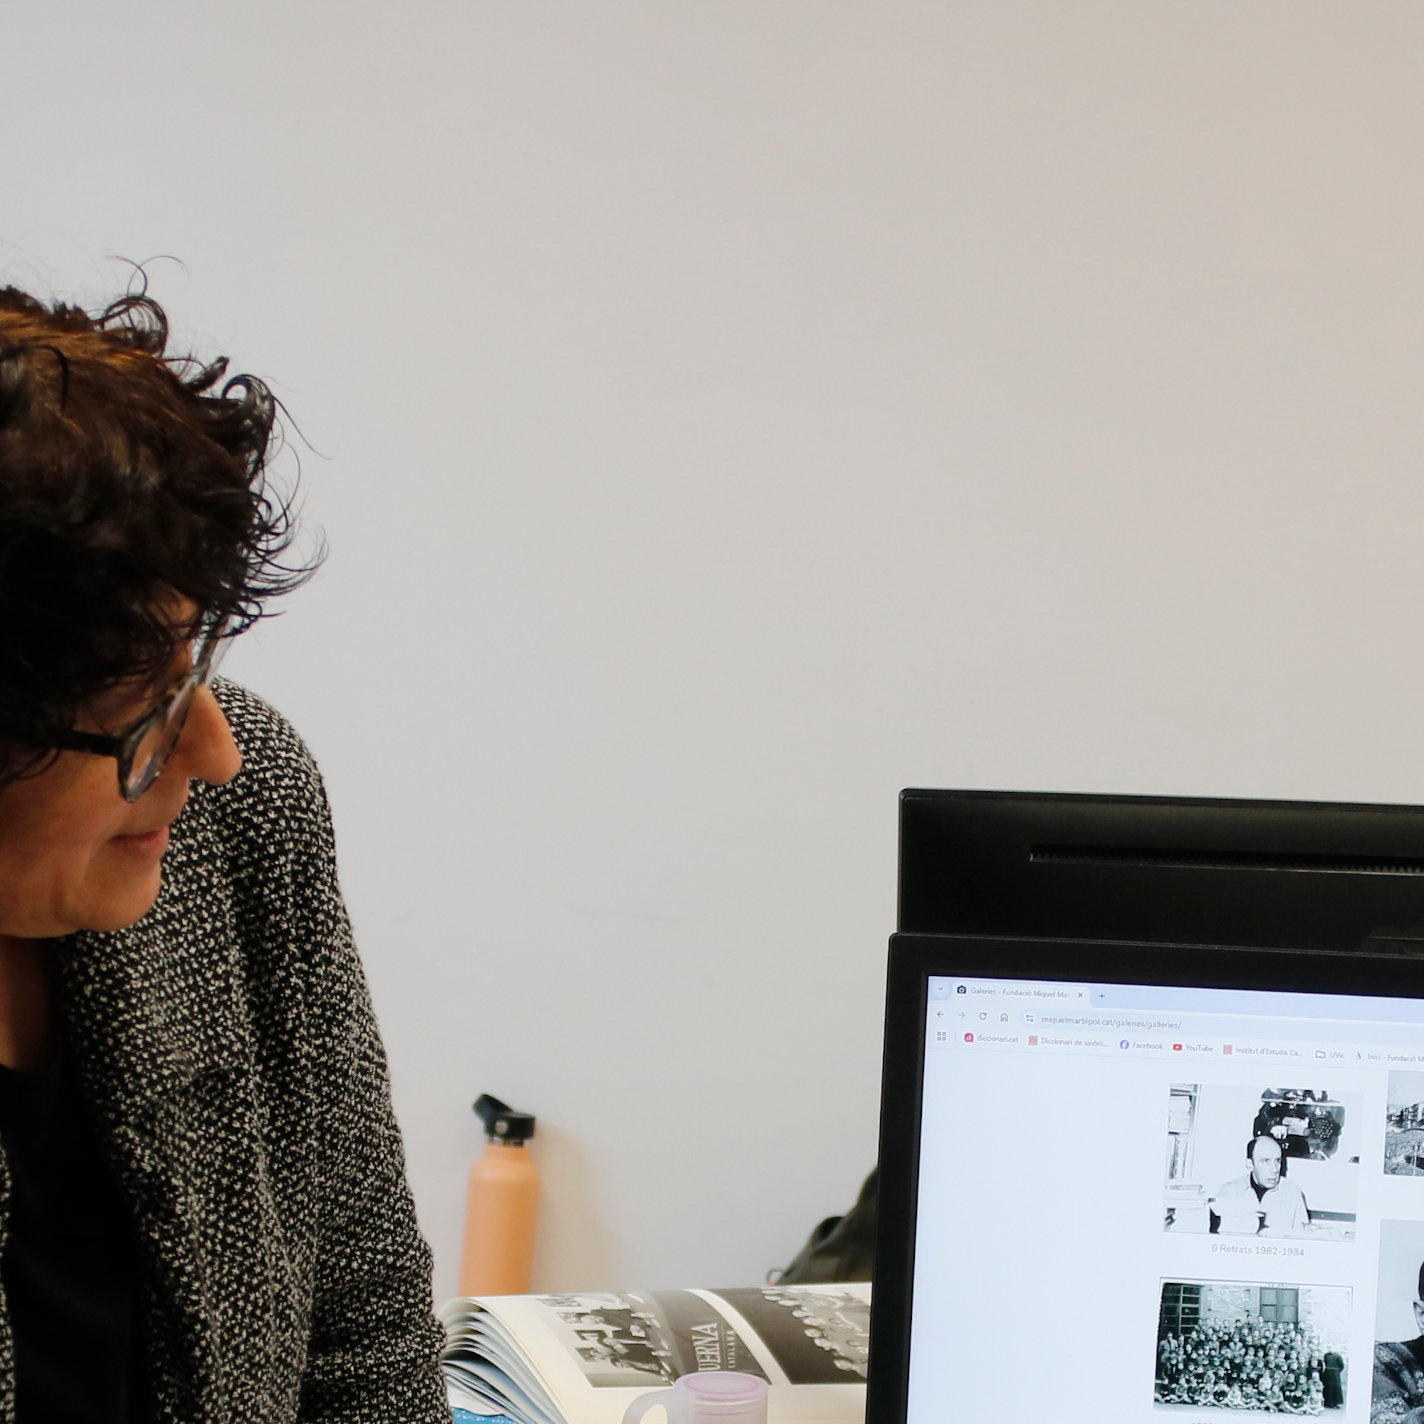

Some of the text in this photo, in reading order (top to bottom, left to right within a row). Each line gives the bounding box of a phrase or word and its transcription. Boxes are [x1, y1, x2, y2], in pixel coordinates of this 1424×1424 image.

[970, 986, 997, 996] Galeries
[1002, 987, 1033, 998] Fundació
[1033, 989, 1056, 1000] Miquel
[1133, 1041, 1163, 1050] Facebook
[1186, 1043, 1213, 1052] YouTube
[1235, 1046, 1258, 1056] Institut
[1211, 1244, 1305, 1256] 0 Retrats 1982-1984
